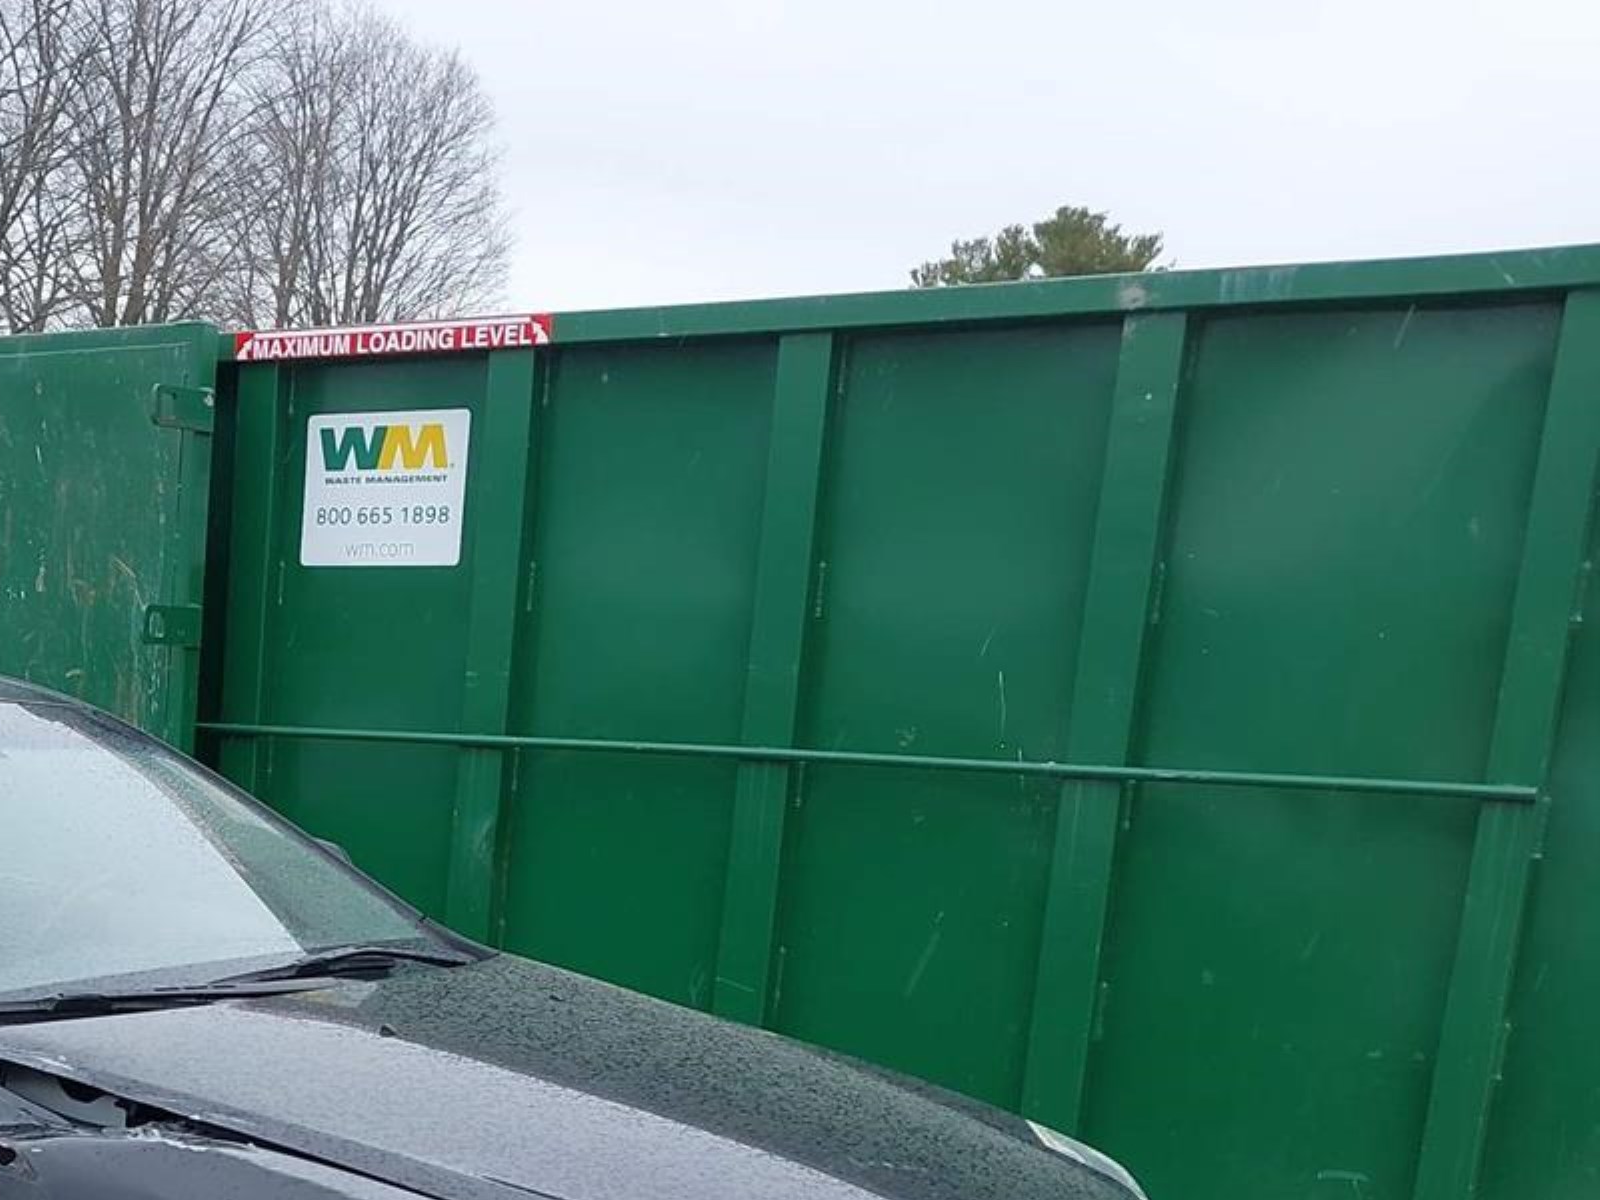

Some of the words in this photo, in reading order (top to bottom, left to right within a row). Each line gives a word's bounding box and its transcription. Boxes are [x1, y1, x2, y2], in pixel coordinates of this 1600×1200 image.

[252, 334, 350, 359] MAXIMUM
[356, 329, 455, 354] LOADING
[460, 324, 531, 347] LEVEL
[319, 424, 449, 471] WM
[325, 476, 362, 485] WASTE
[365, 475, 448, 484] MANAGEMENT
[316, 507, 351, 524] 800
[357, 507, 392, 524] 665
[401, 506, 450, 524] 1898
[345, 543, 414, 557] wm.com
